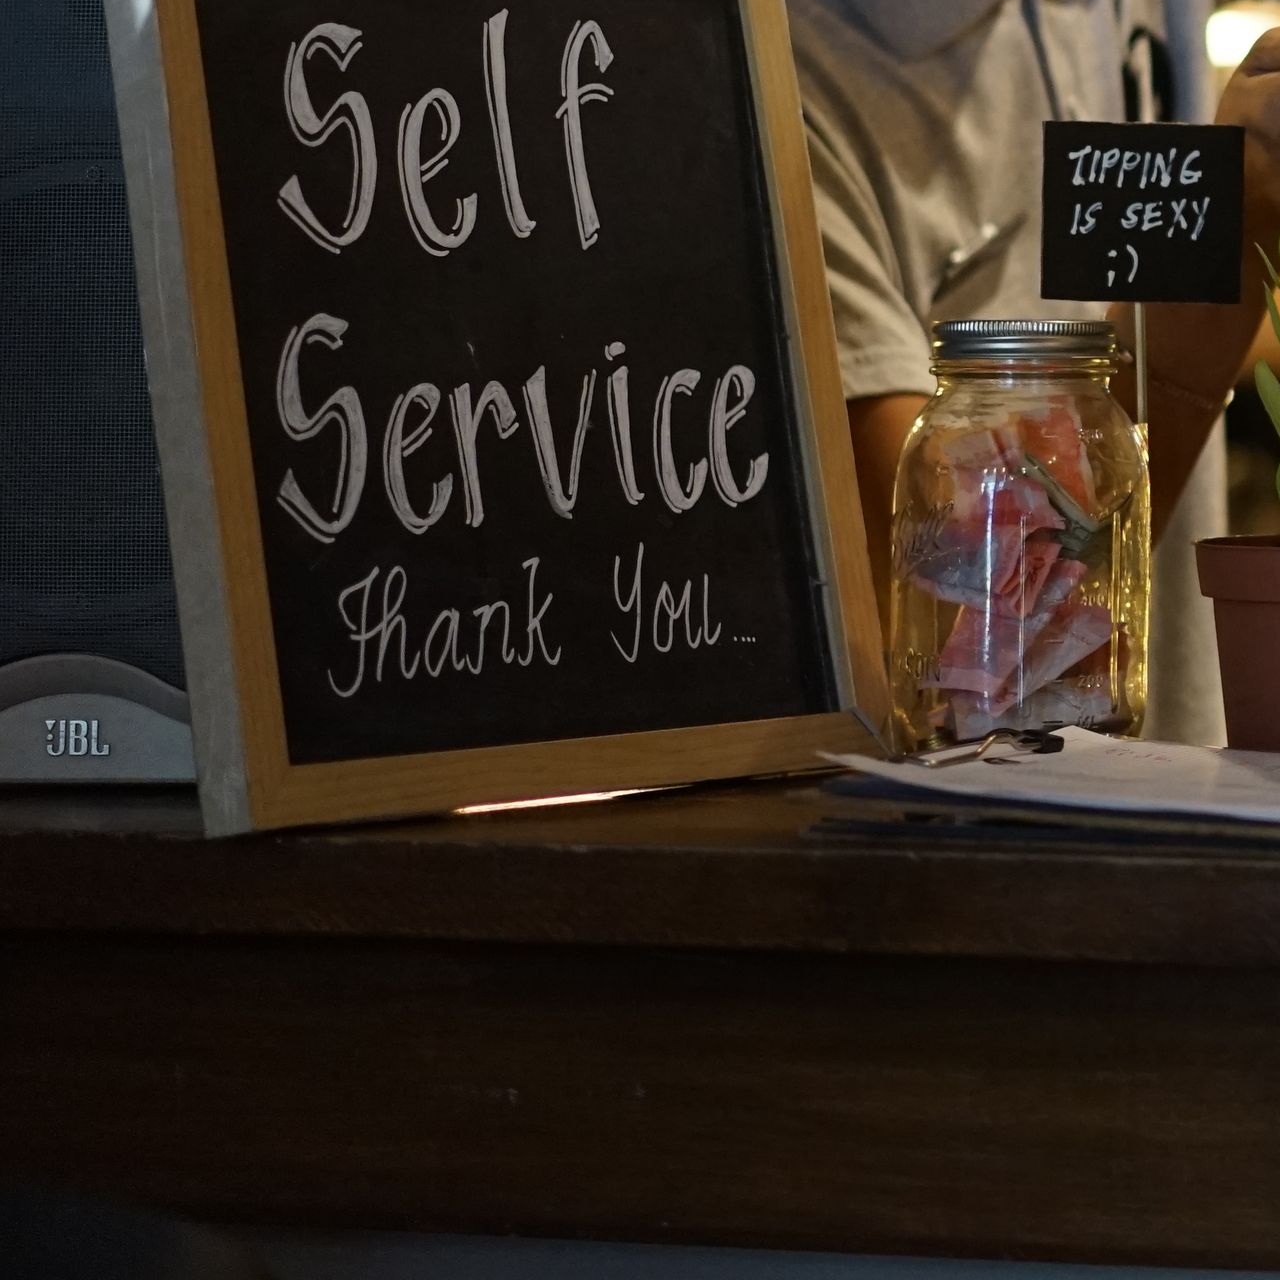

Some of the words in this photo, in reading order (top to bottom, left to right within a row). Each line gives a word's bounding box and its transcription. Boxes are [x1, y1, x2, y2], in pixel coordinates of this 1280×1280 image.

[277, 8, 615, 257] Self
[1068, 145, 1202, 189] TIPPING
[1070, 201, 1103, 236] IS
[1121, 196, 1211, 241] SEXY
[276, 312, 769, 544] Service
[328, 557, 561, 698] Thank
[45, 719, 109, 756] JBL
